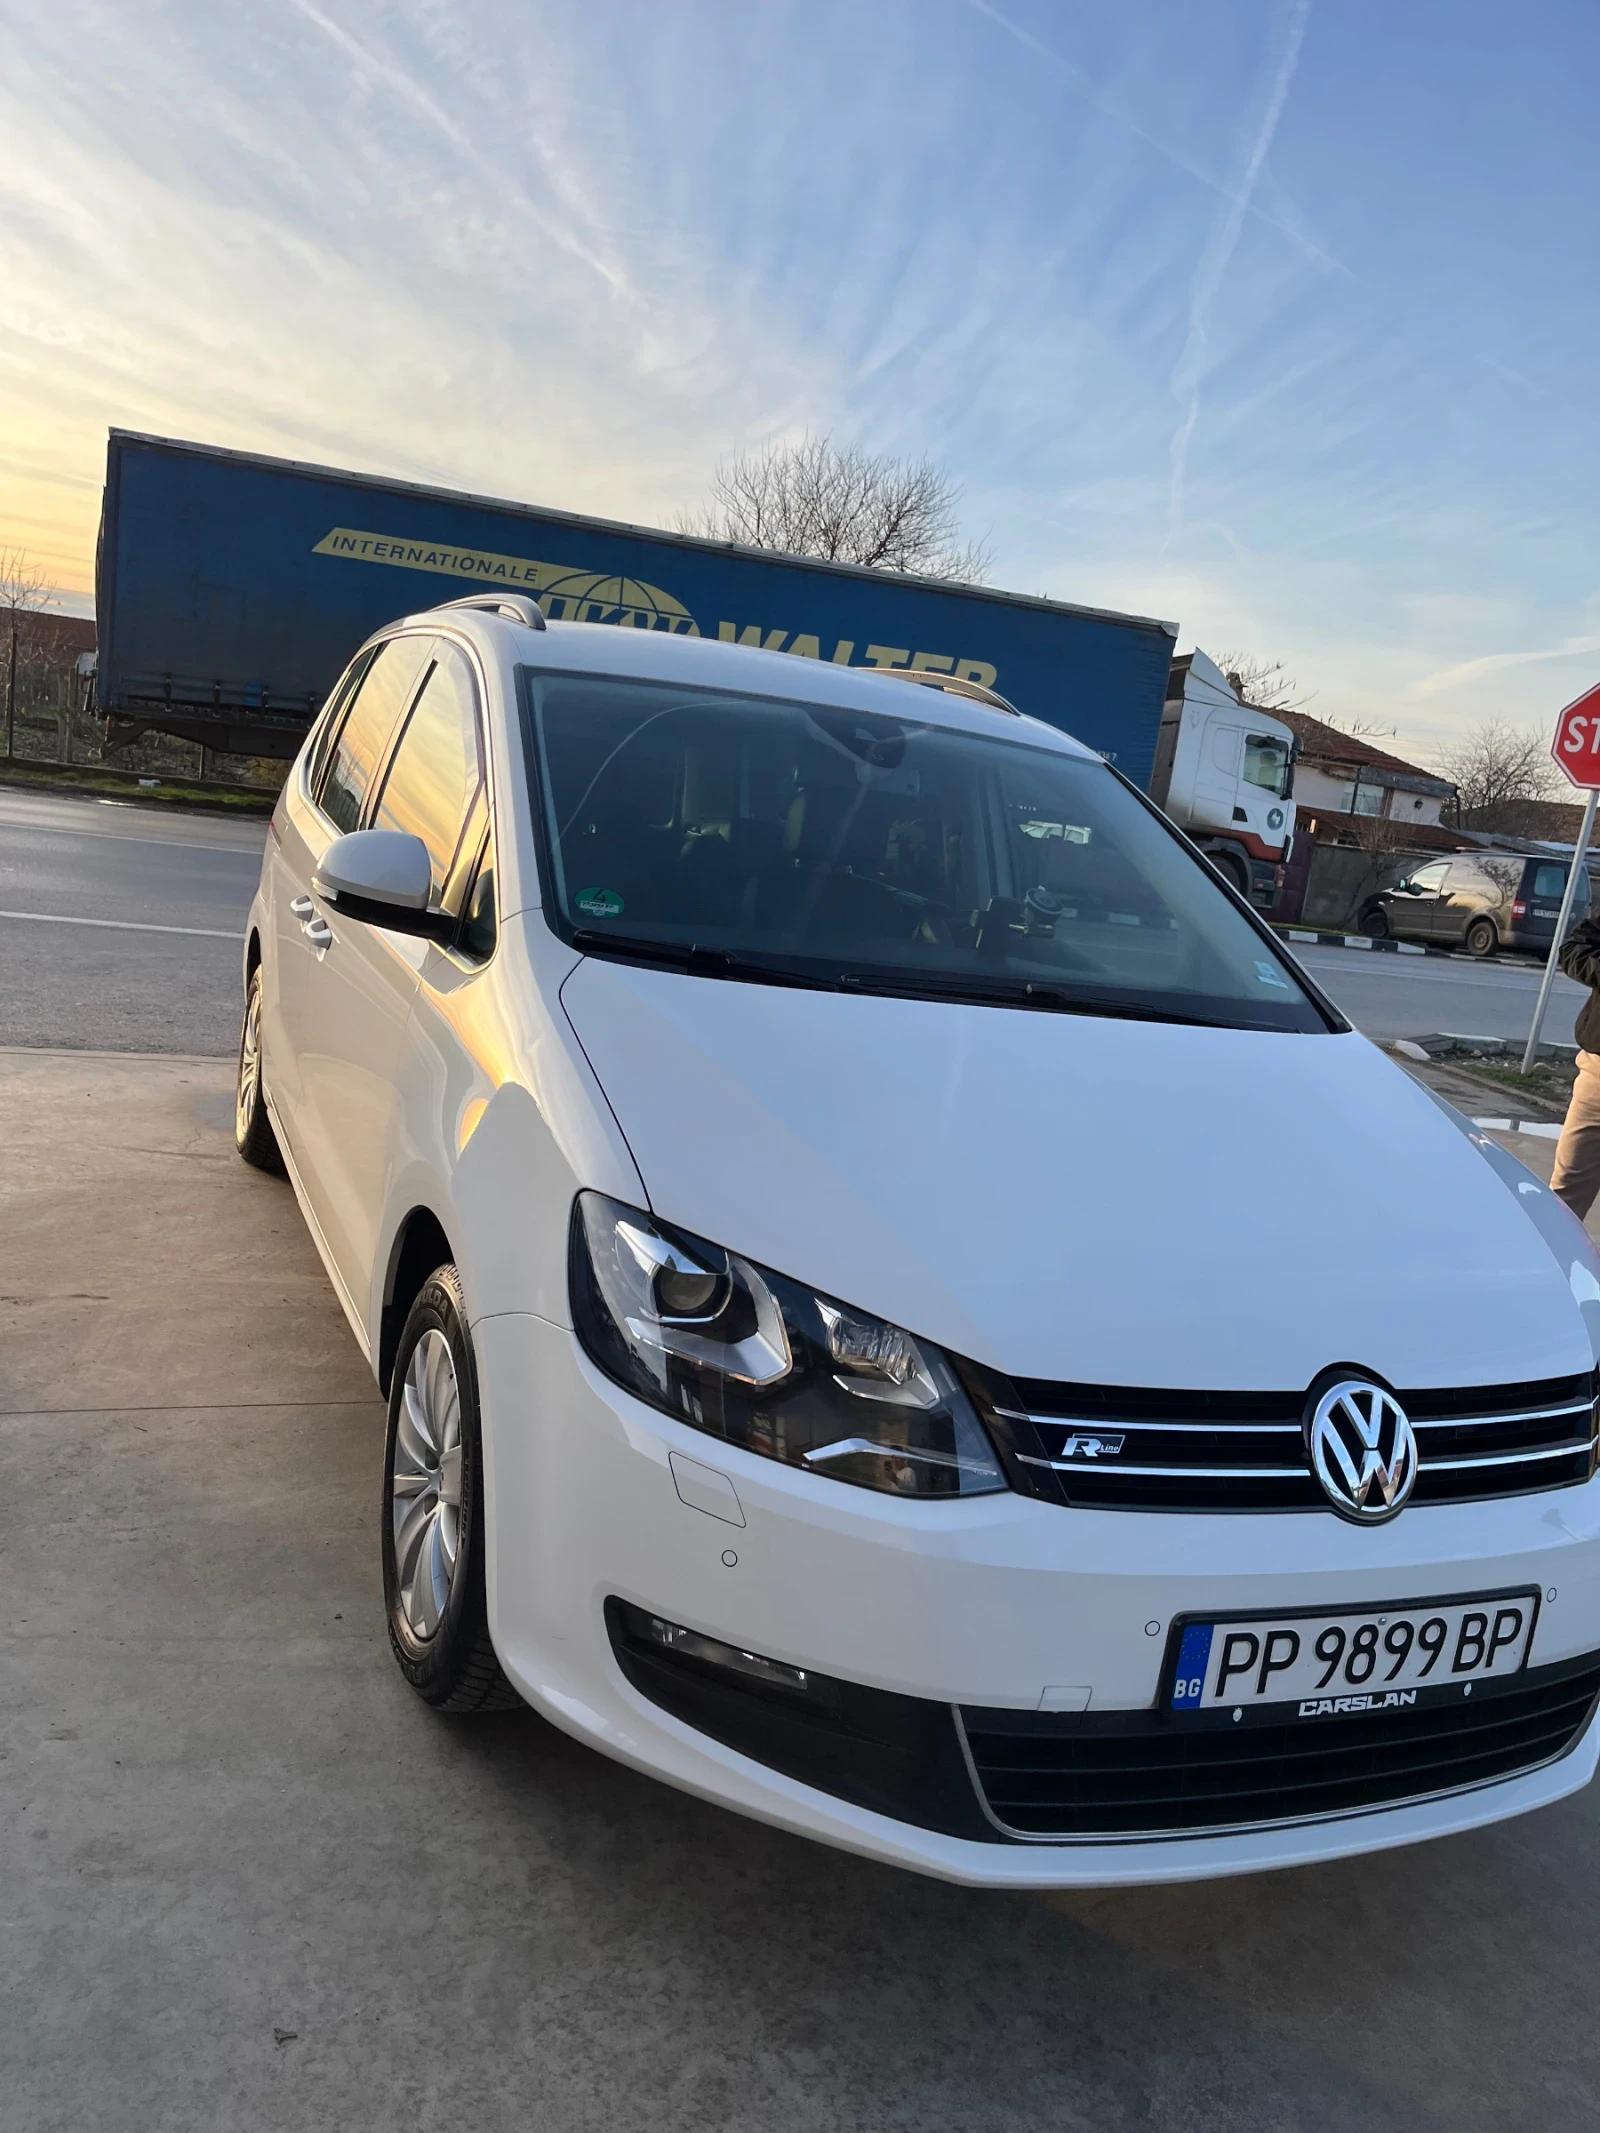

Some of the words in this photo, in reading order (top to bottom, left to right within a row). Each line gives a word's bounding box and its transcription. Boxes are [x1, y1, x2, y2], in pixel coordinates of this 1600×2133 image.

[332, 536, 539, 582] INTERNATIONALE
[1214, 1630, 1300, 1698] PP
[1314, 1616, 1448, 1689] 9899
[1451, 1607, 1523, 1673] BP
[1173, 1678, 1202, 1699] BG
[1298, 1690, 1417, 1717] CARSLAN
